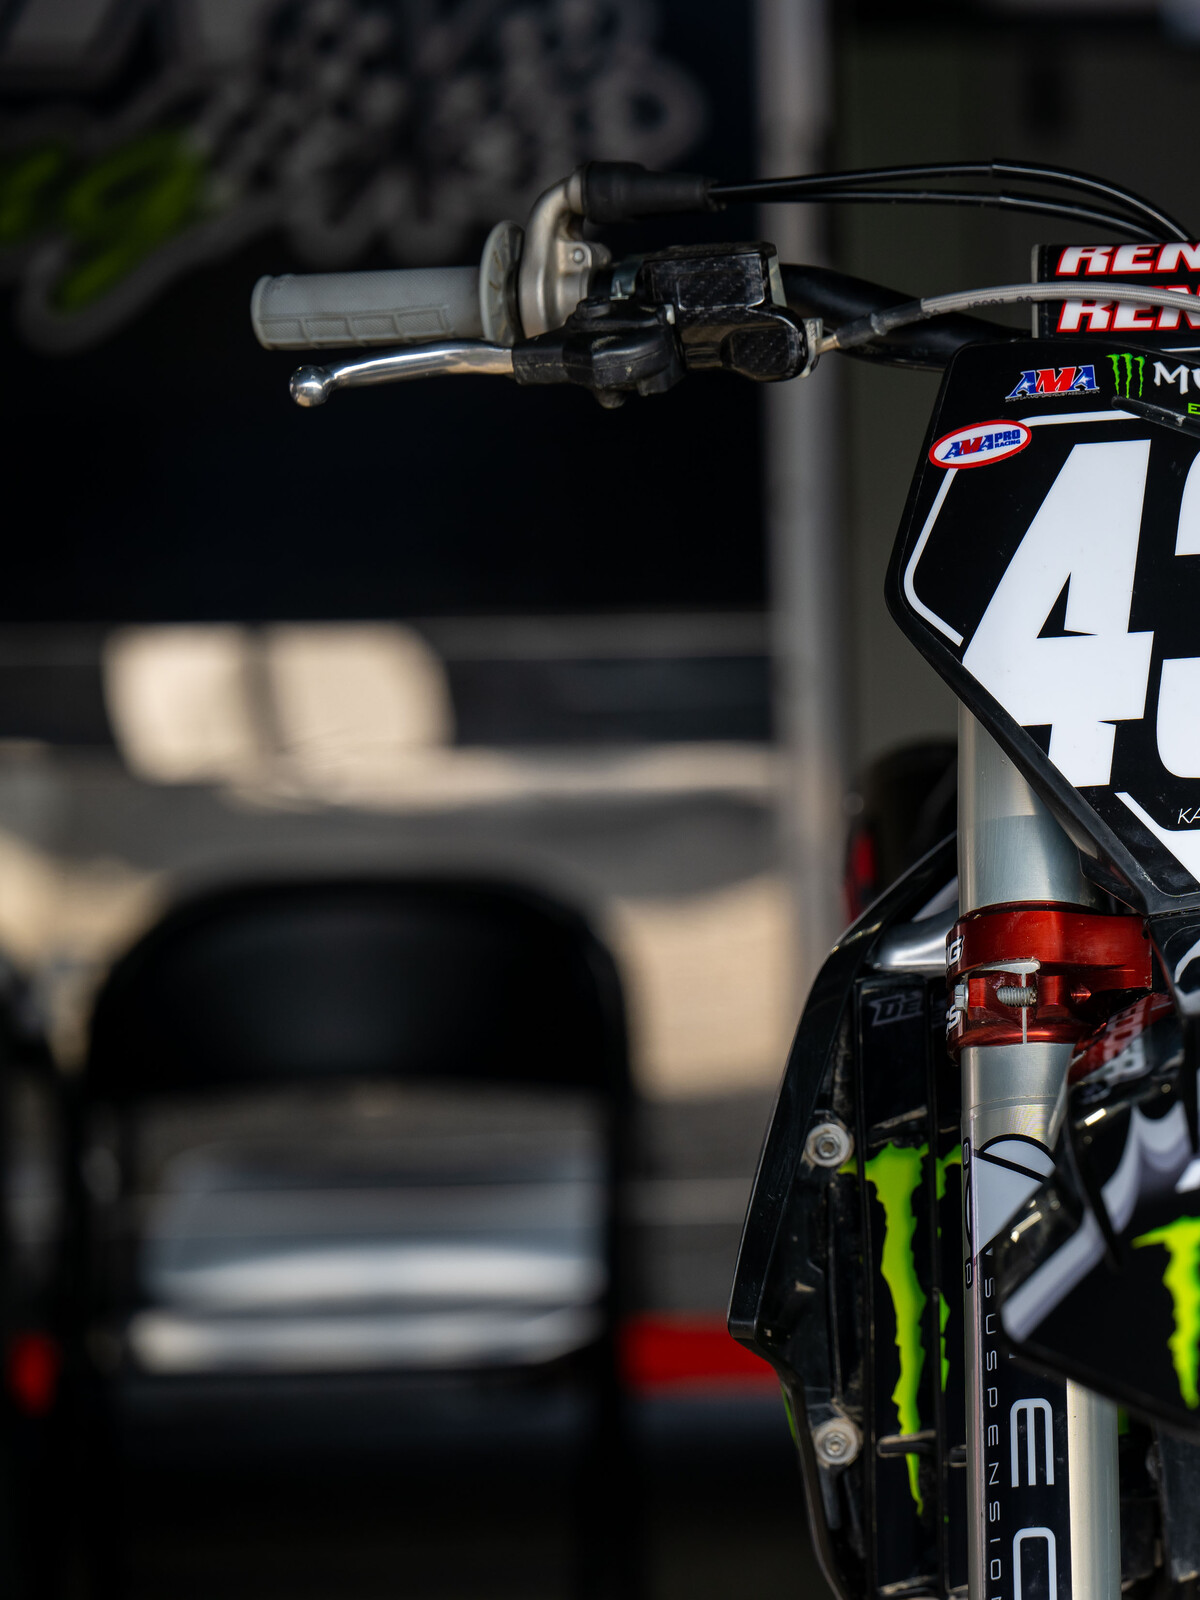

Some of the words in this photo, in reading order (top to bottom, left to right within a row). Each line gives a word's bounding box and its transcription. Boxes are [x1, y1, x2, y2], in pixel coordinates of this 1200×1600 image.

[1005, 364, 1100, 400] AMA
[940, 433, 994, 461] AMA
[994, 429, 1021, 443] PRO
[994, 439, 1021, 449] RACING
[984, 1278, 1002, 1600] SUSPENSIO
[1009, 1397, 1058, 1600] EO
